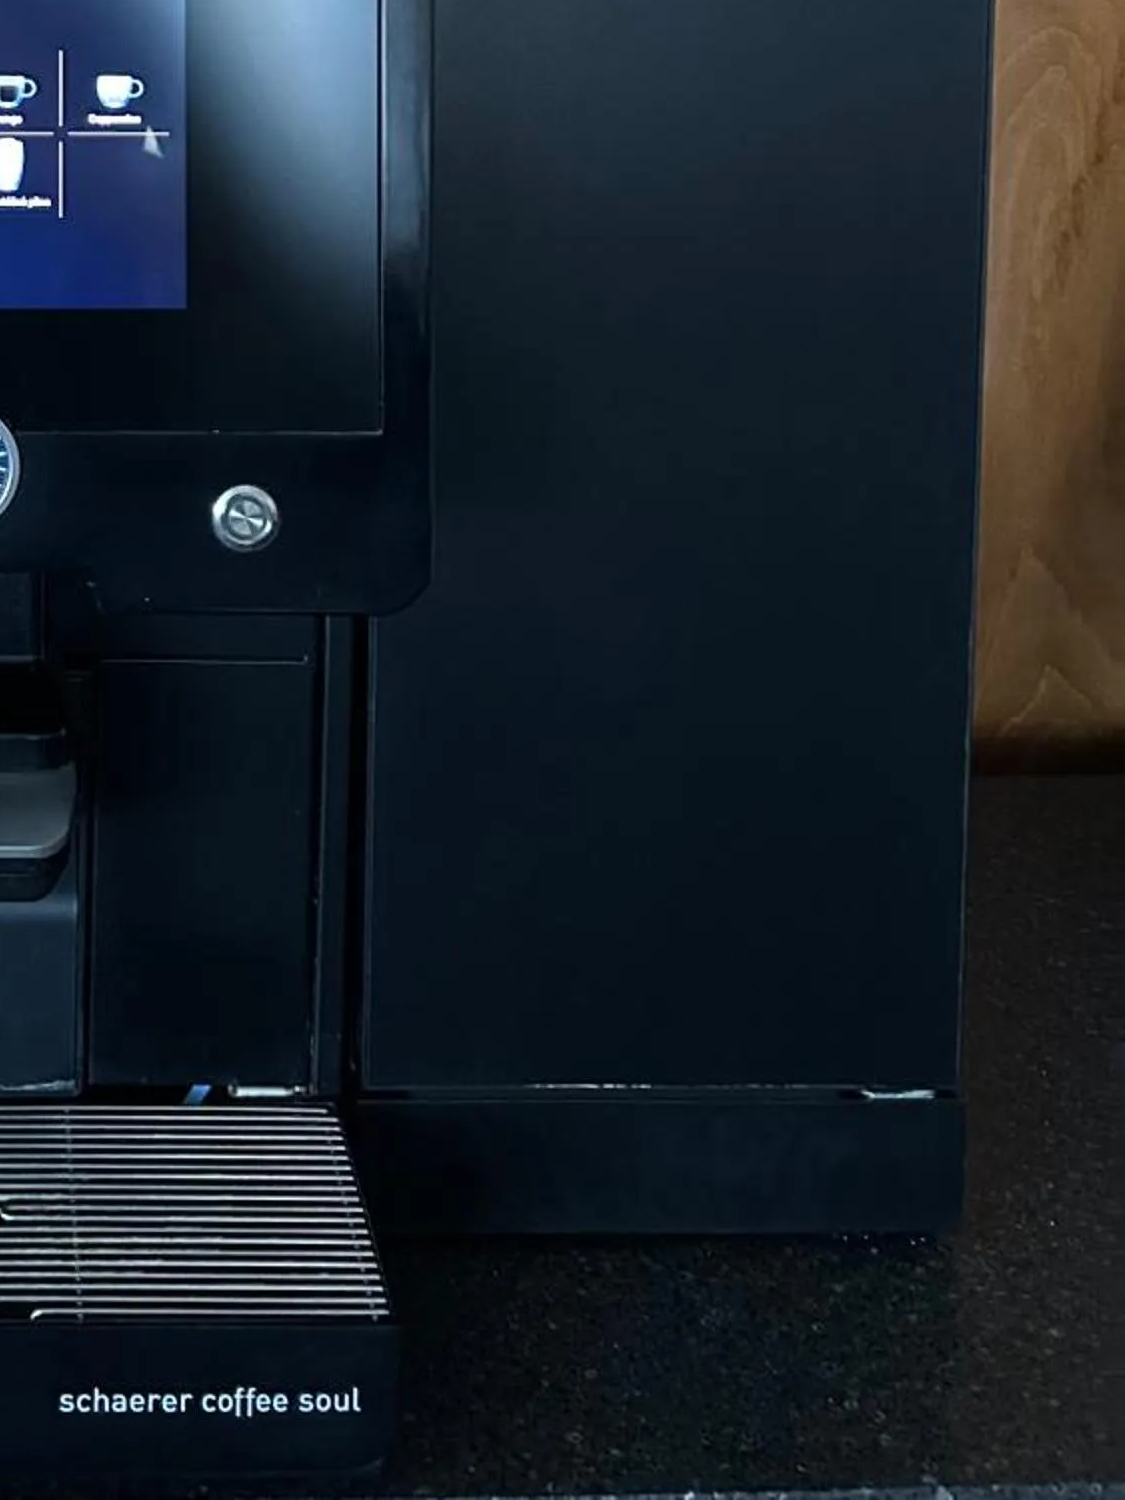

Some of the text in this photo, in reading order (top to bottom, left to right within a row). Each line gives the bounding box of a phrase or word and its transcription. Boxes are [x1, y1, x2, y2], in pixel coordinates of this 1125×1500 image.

[59, 1387, 362, 1418] schaerer coffee soul
